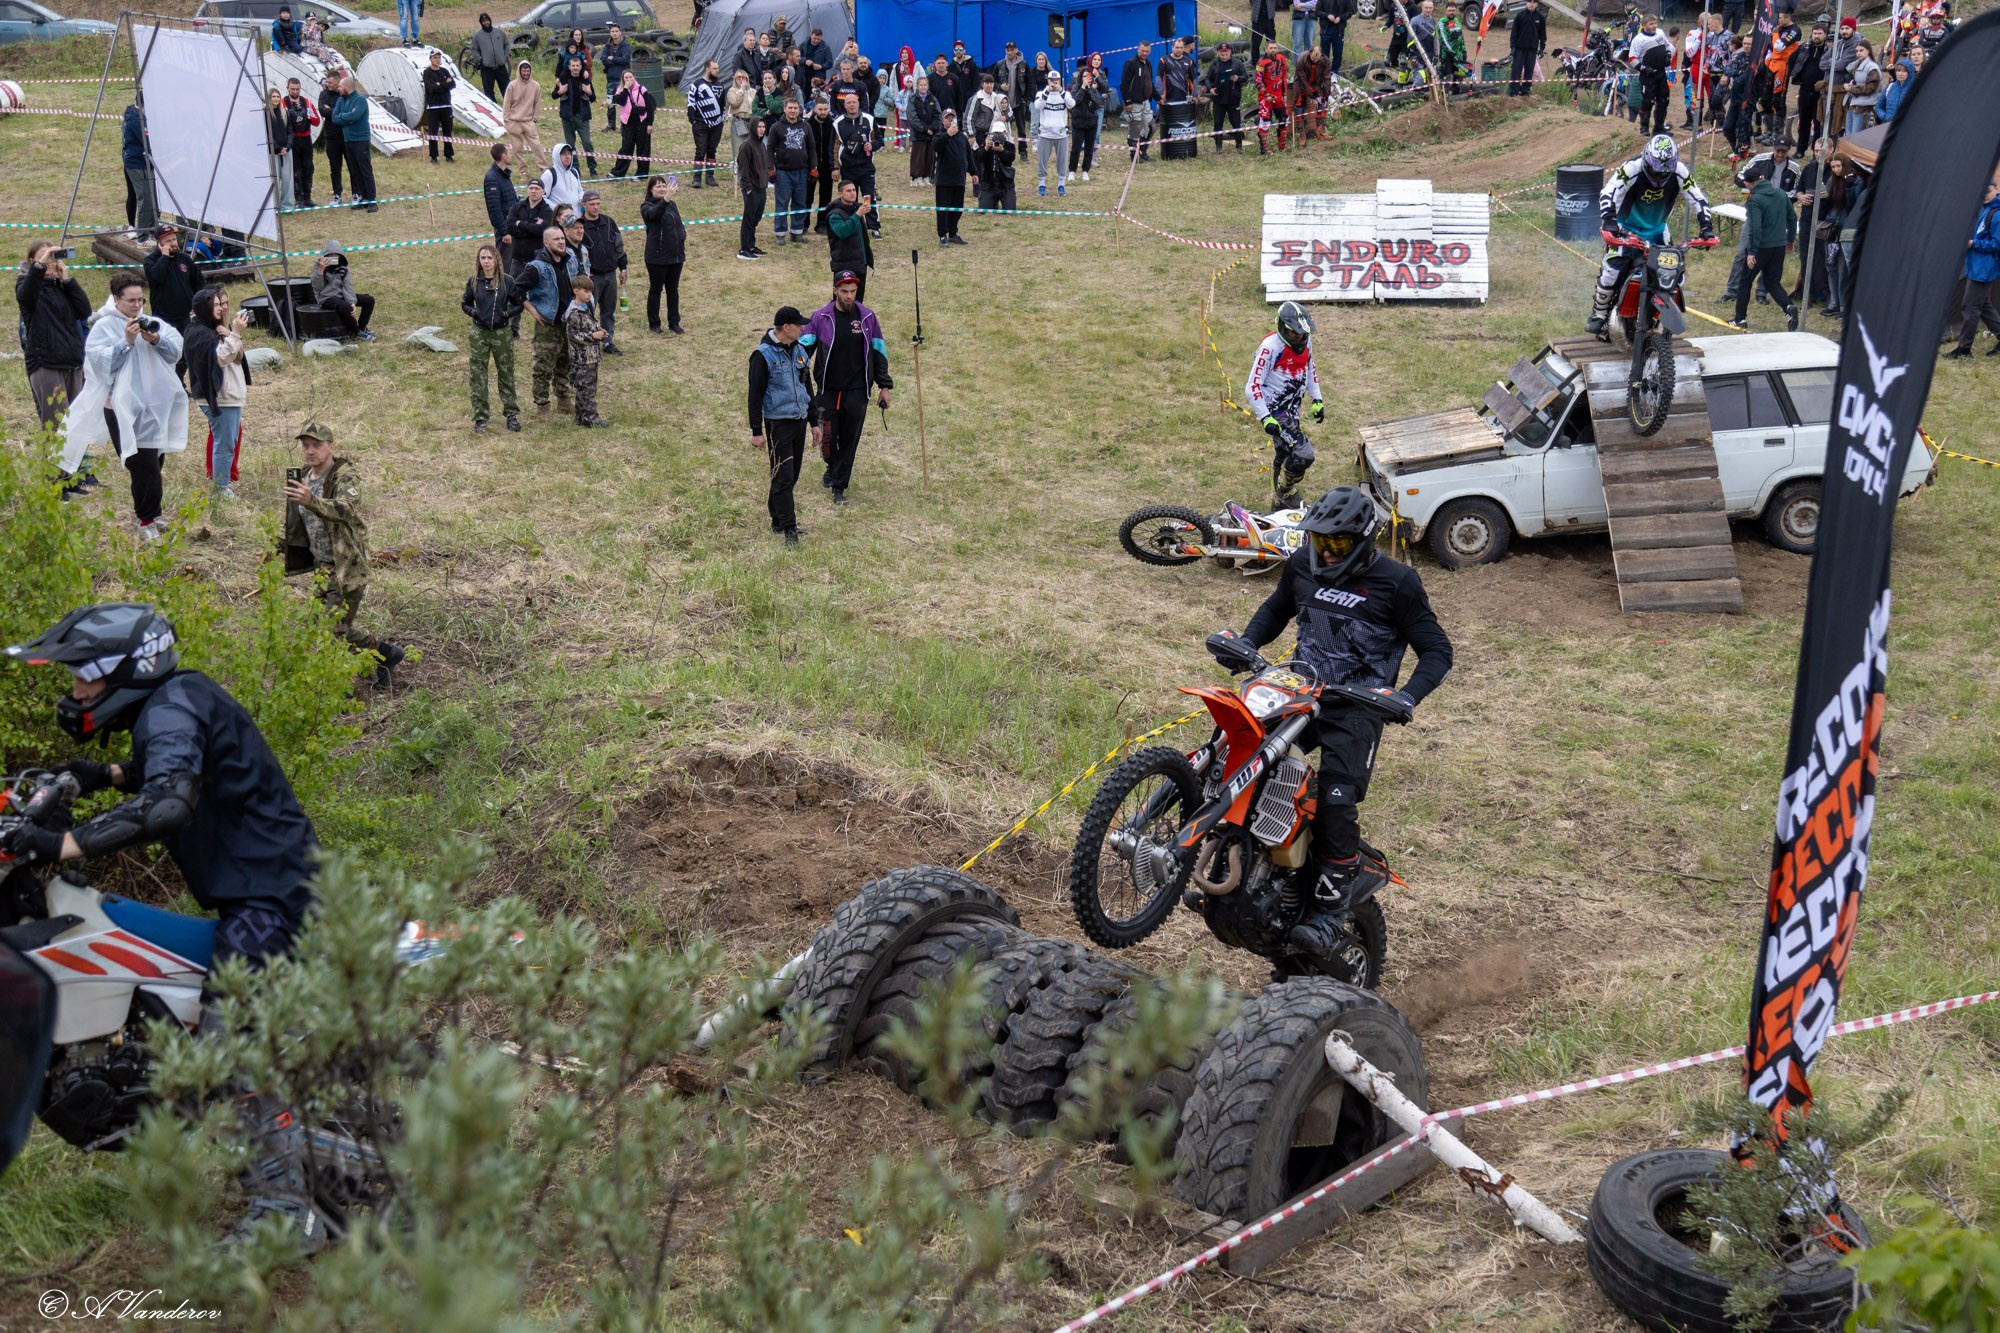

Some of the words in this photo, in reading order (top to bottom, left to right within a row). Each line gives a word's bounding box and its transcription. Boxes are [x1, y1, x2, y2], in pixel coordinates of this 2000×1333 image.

[1271, 238, 1472, 267] ENDURO
[1293, 262, 1444, 290] СТАЛЬ
[1251, 348, 1270, 401] РОССИЯ
